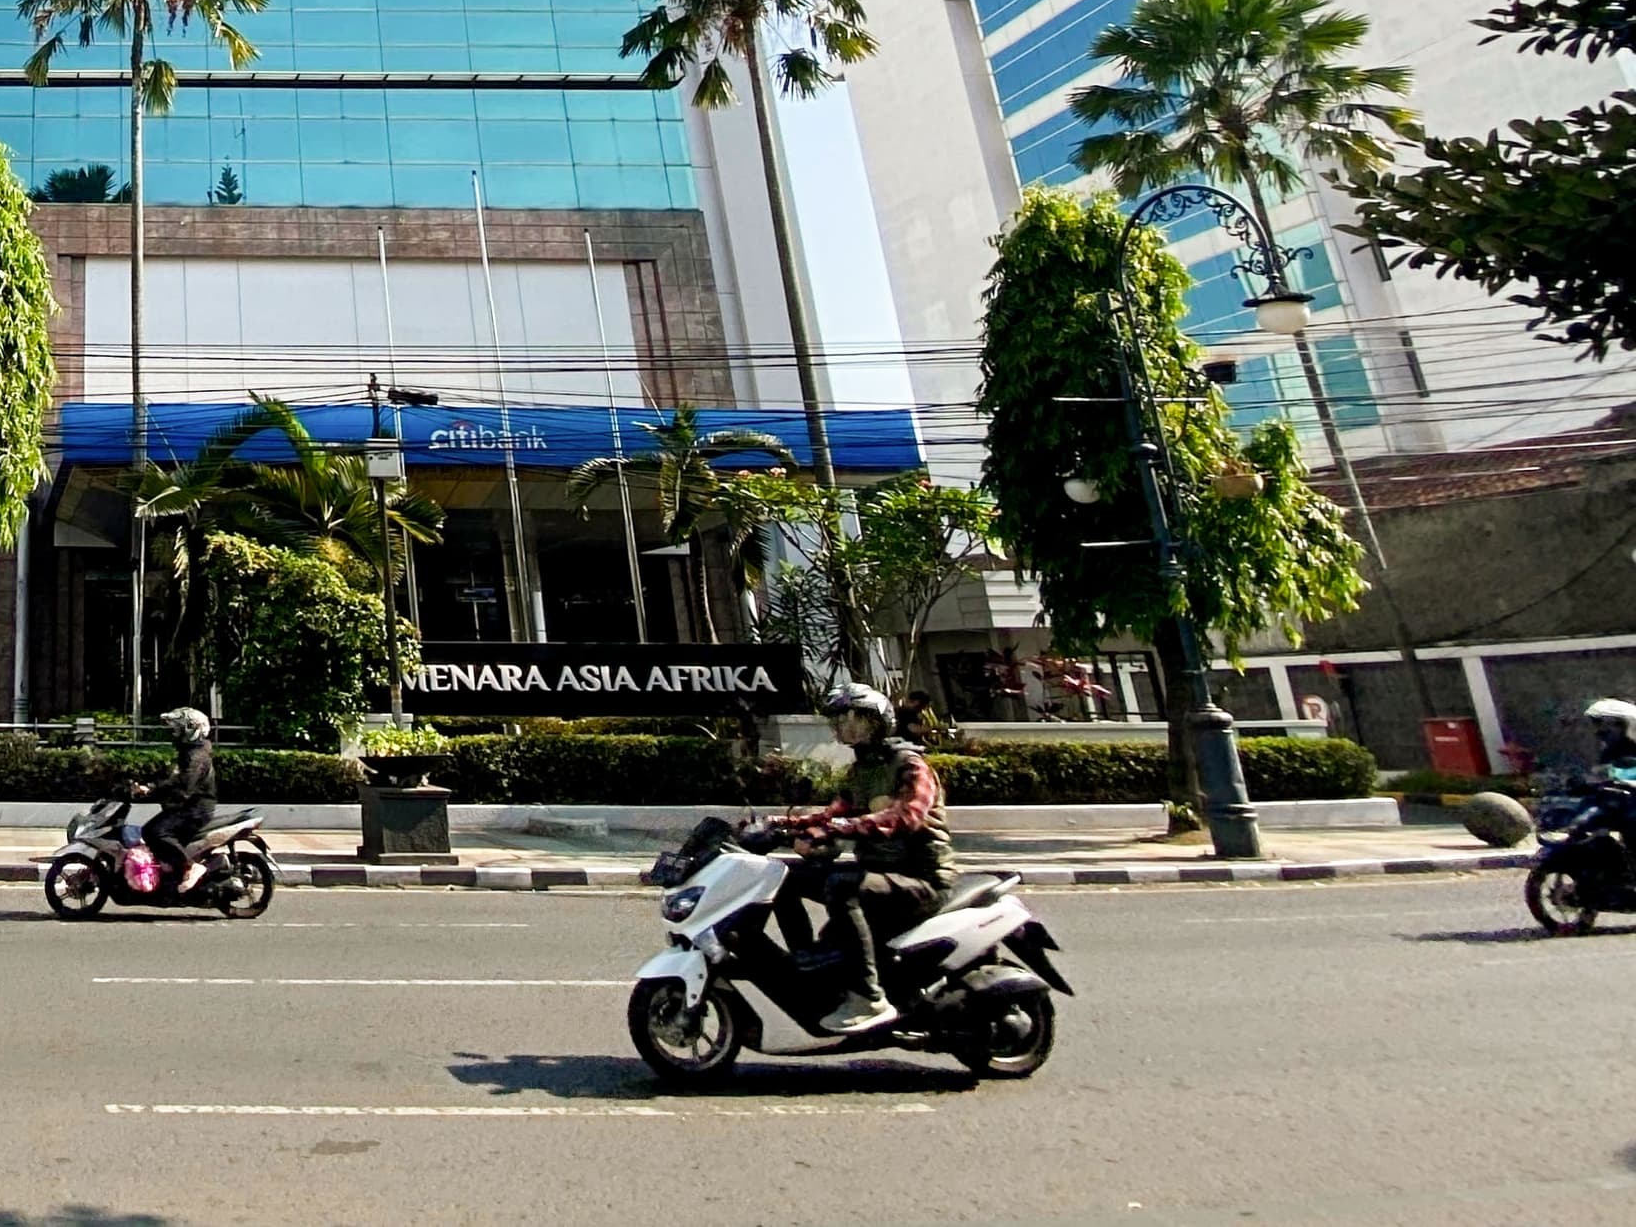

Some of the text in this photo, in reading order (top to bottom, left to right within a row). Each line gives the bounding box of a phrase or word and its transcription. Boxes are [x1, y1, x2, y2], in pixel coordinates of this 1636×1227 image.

[428, 424, 548, 450] citibank
[556, 665, 641, 693] ASIA
[645, 666, 778, 693] AFRIKA
